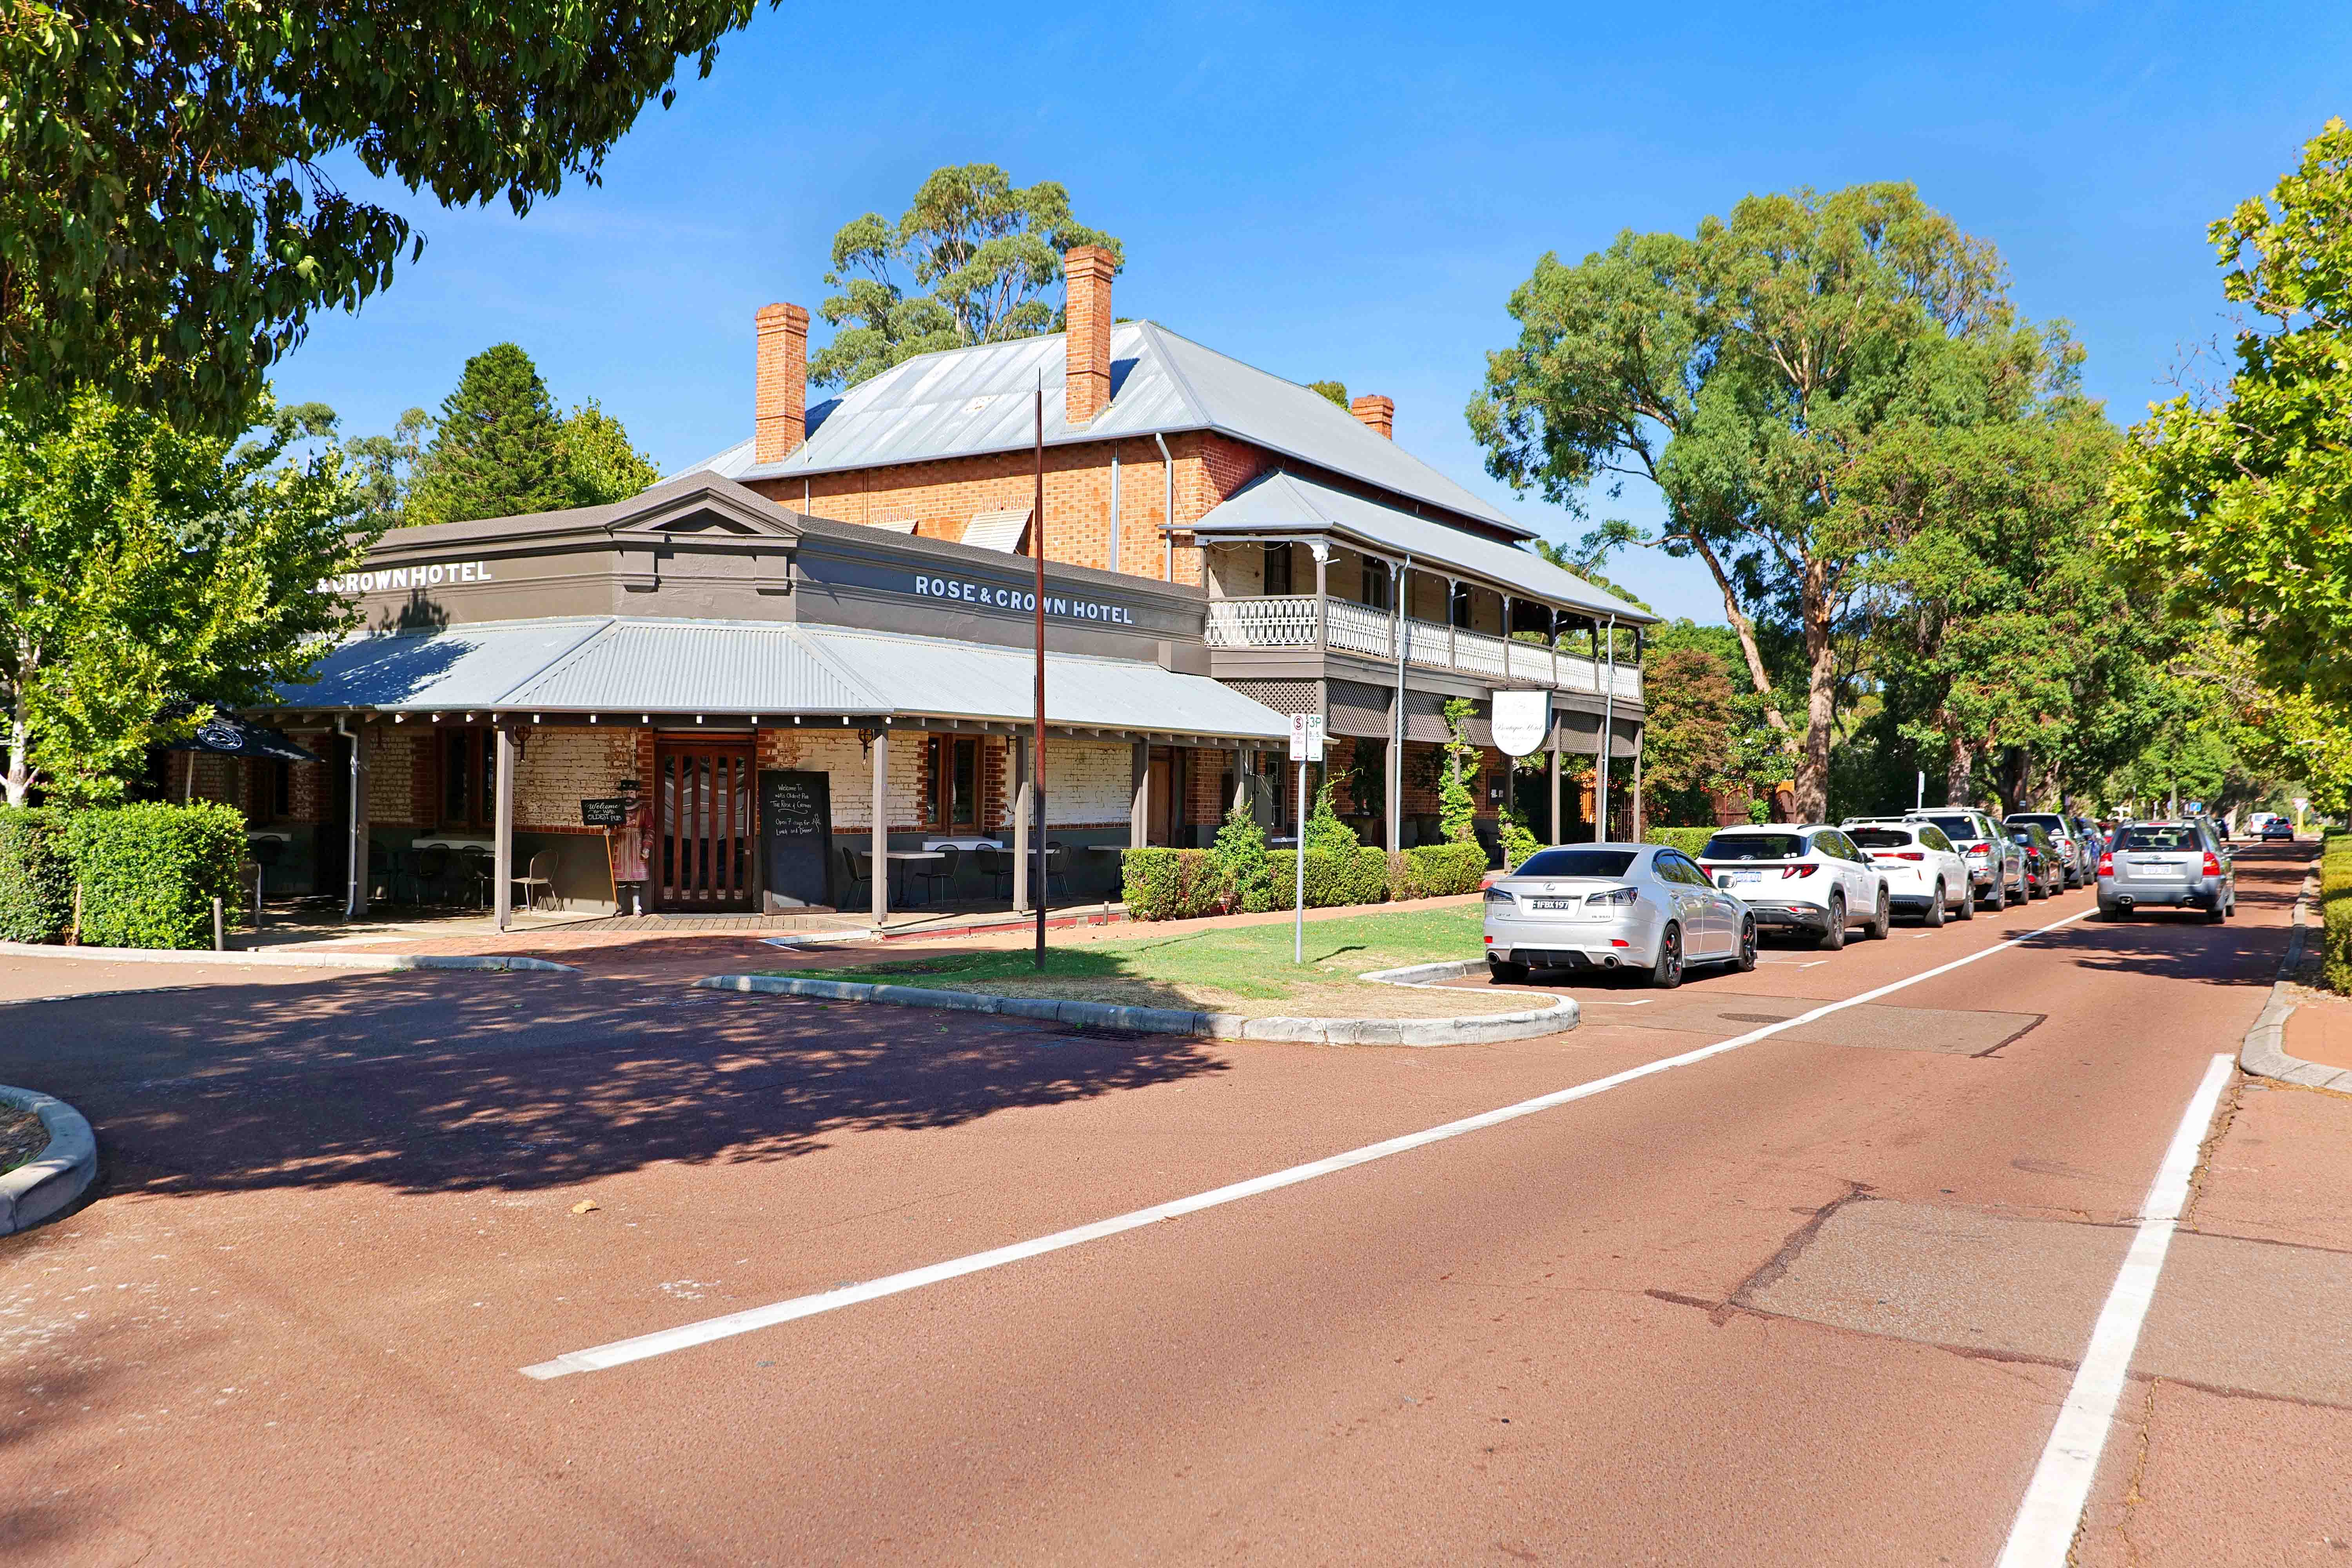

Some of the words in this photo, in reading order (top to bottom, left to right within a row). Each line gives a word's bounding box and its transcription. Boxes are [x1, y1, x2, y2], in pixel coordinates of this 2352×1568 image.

[332, 569, 408, 592] CROWN
[411, 561, 492, 586] HOTEL
[915, 576, 975, 602] ROSE
[980, 588, 991, 603] &
[1073, 601, 1132, 624] HOTEL
[1310, 717, 1321, 728] 3P
